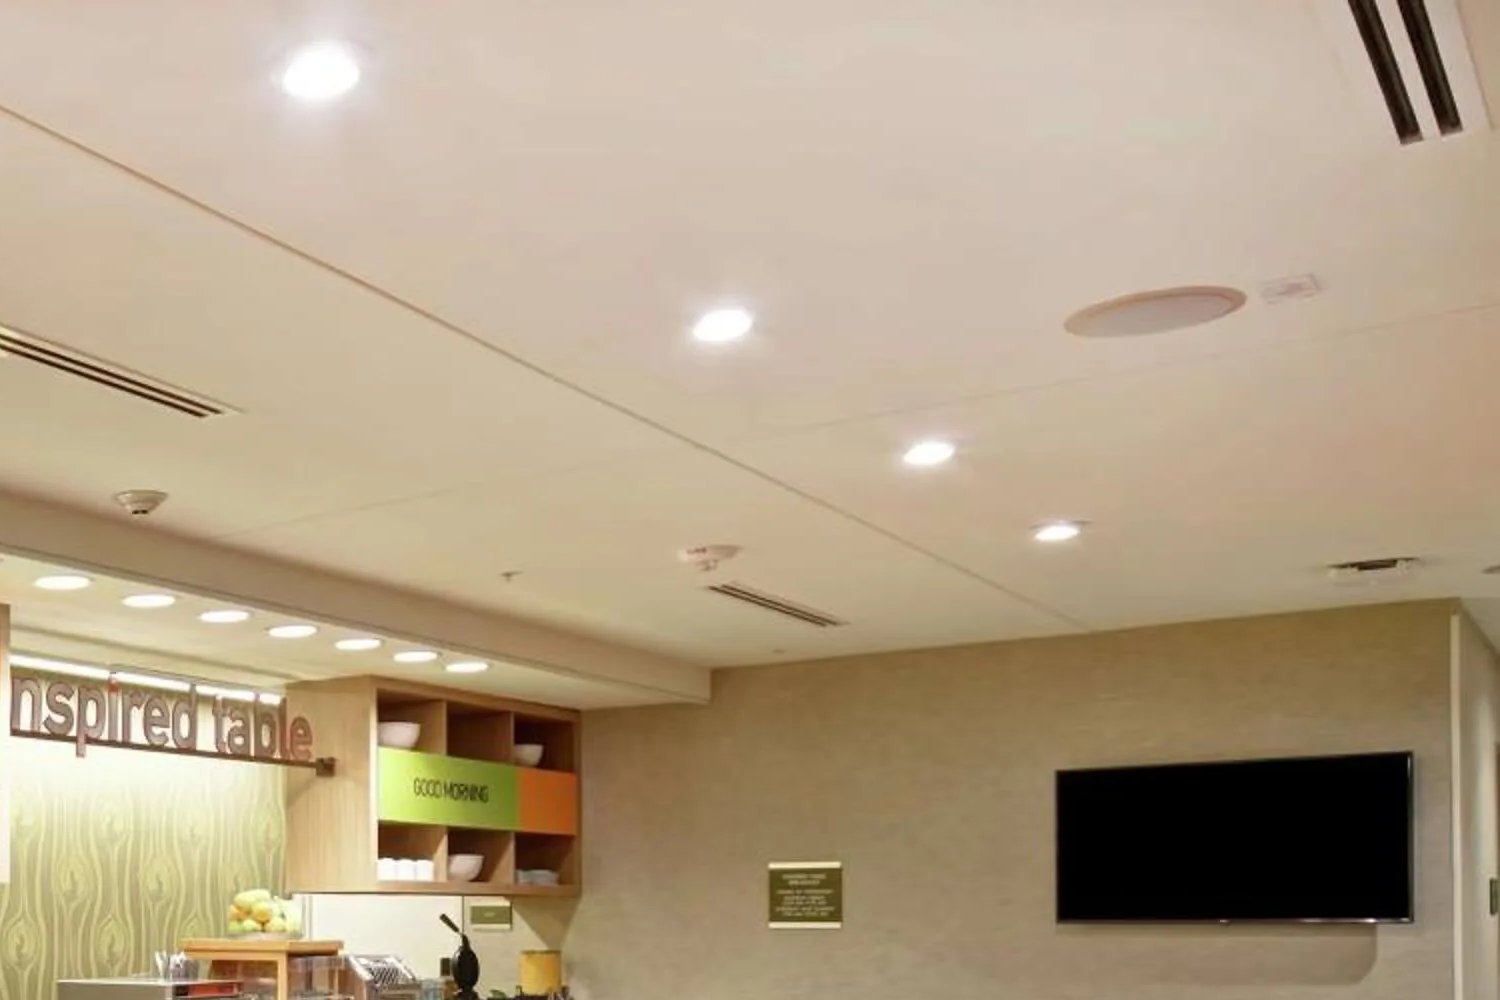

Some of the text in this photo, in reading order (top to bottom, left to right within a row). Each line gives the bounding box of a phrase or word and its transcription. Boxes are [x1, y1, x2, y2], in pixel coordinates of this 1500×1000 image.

[212, 694, 313, 761] table
[412, 777, 489, 804] GOOD MORNING
